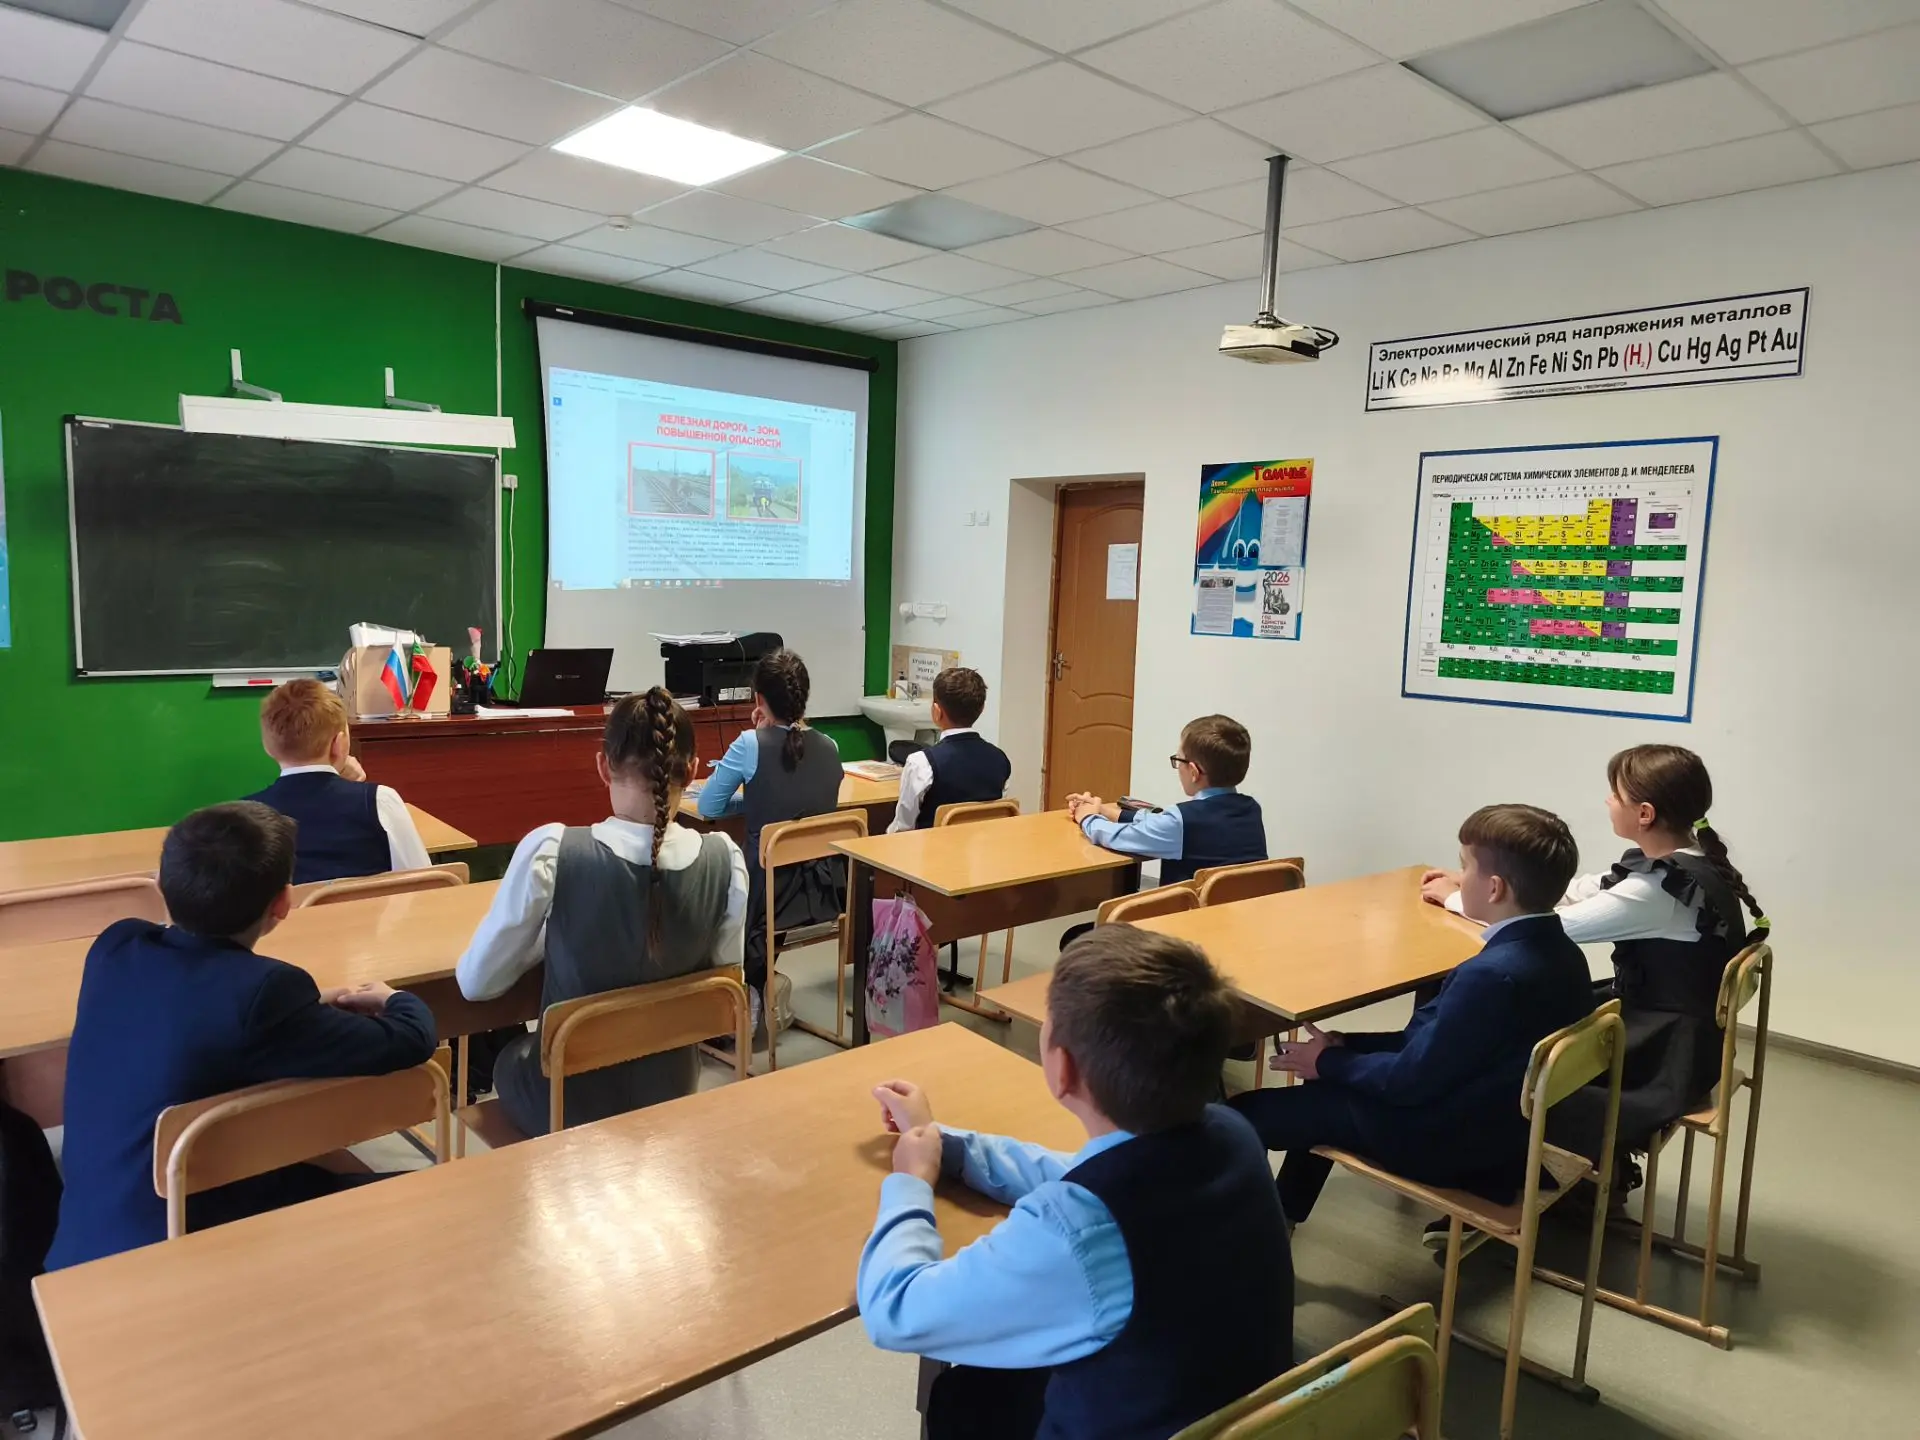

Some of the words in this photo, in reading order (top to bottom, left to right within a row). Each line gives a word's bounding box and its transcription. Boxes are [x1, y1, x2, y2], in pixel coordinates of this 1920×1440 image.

[6, 269, 183, 325] РОСТА
[1379, 332, 1530, 361] Электрохимический
[1536, 330, 1566, 347] ряд
[1572, 316, 1684, 339] напряжения
[1690, 303, 1792, 326] металлов
[1372, 371, 1384, 391] Li
[1387, 369, 1397, 389] K
[1400, 367, 1417, 387] Ca
[1488, 358, 1503, 379] Al
[1506, 356, 1525, 378] Zn
[1529, 354, 1547, 376] Fe
[1552, 351, 1568, 374] Ni
[1572, 349, 1593, 372] Sn
[1598, 346, 1619, 369] Pb
[1658, 340, 1682, 363] Cu
[1687, 336, 1711, 364] Hg
[1716, 333, 1741, 362] Ag
[1747, 330, 1767, 354] Pt
[1771, 327, 1798, 353] Au
[659, 413, 711, 427] ЖЕЛЕЗНАЯ
[713, 420, 748, 433] ДОРОГА
[757, 425, 780, 436] ЗОНА
[656, 426, 727, 443] ПОВЫШЕННОЙ
[729, 435, 782, 448] ОПАСНОСТИ
[1432, 472, 1489, 484] ПЕРИОДИЧЕСКАЯ
[1490, 471, 1521, 481] СИСТЕМА
[1523, 469, 1572, 480] ХИМИЧЕСКИХ
[1574, 467, 1619, 478] ЭЛЕМЕНТОВ
[1640, 464, 1695, 477] МЕНДЕЛЕЕВА
[1264, 572, 1290, 583] 2026
